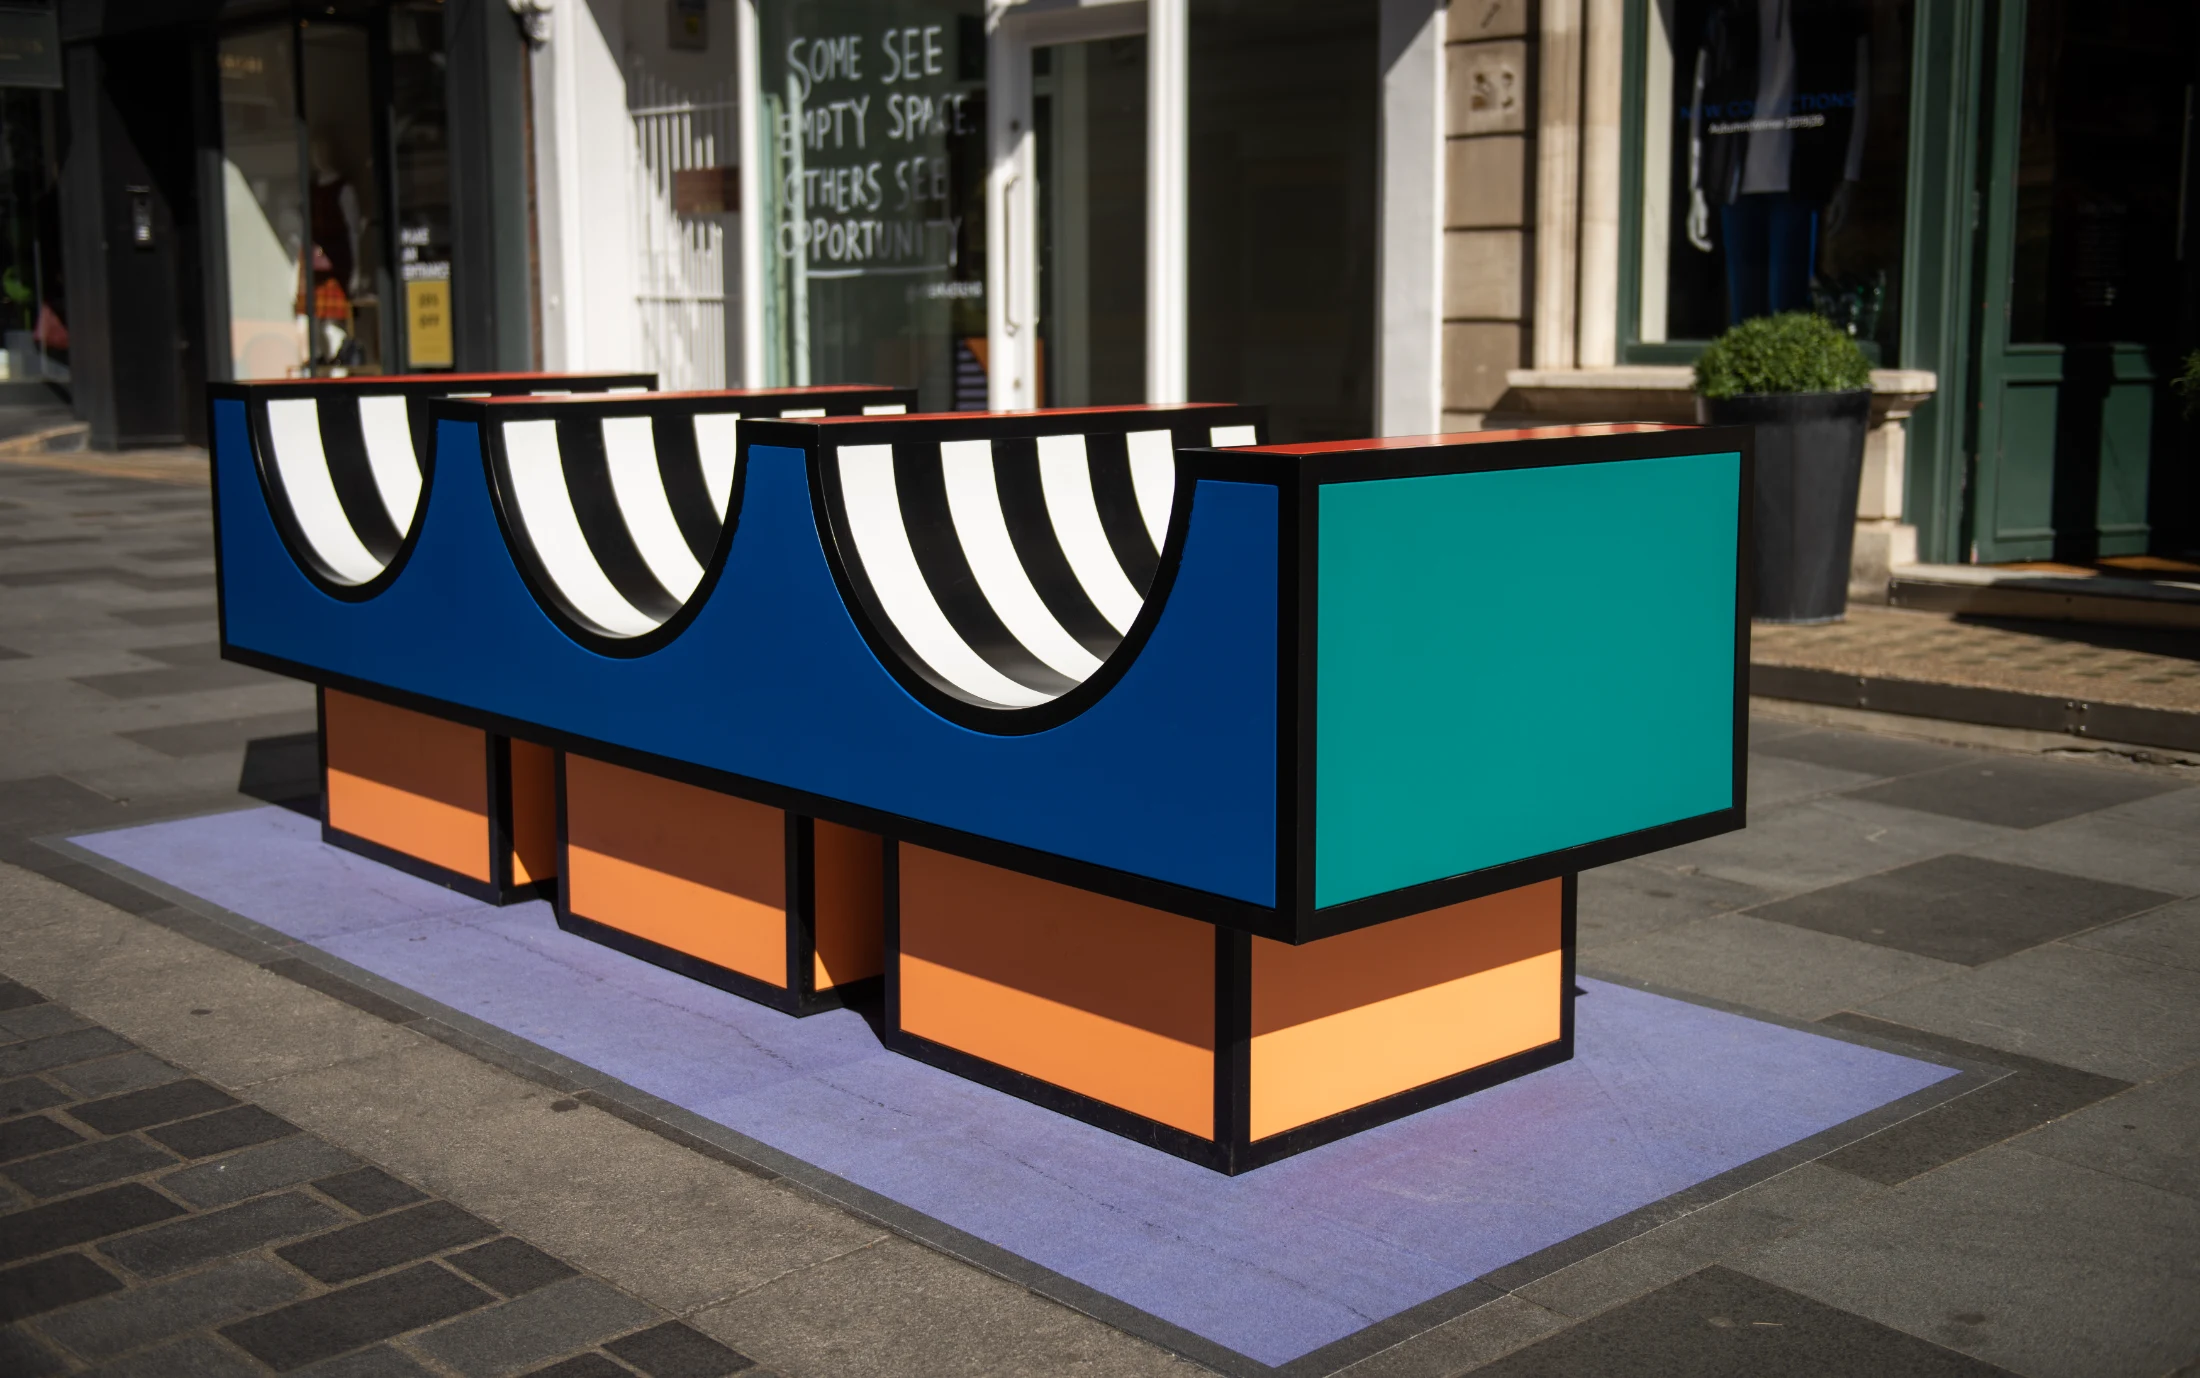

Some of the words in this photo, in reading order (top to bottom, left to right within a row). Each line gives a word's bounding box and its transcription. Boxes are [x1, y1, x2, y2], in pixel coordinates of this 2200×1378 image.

[786, 36, 863, 101] SOME
[881, 25, 943, 84] SEE
[779, 94, 870, 158] EMPTY
[783, 161, 883, 214] OTHERS
[894, 156, 948, 212] SEE
[776, 216, 963, 266] OPPORTUNITY
